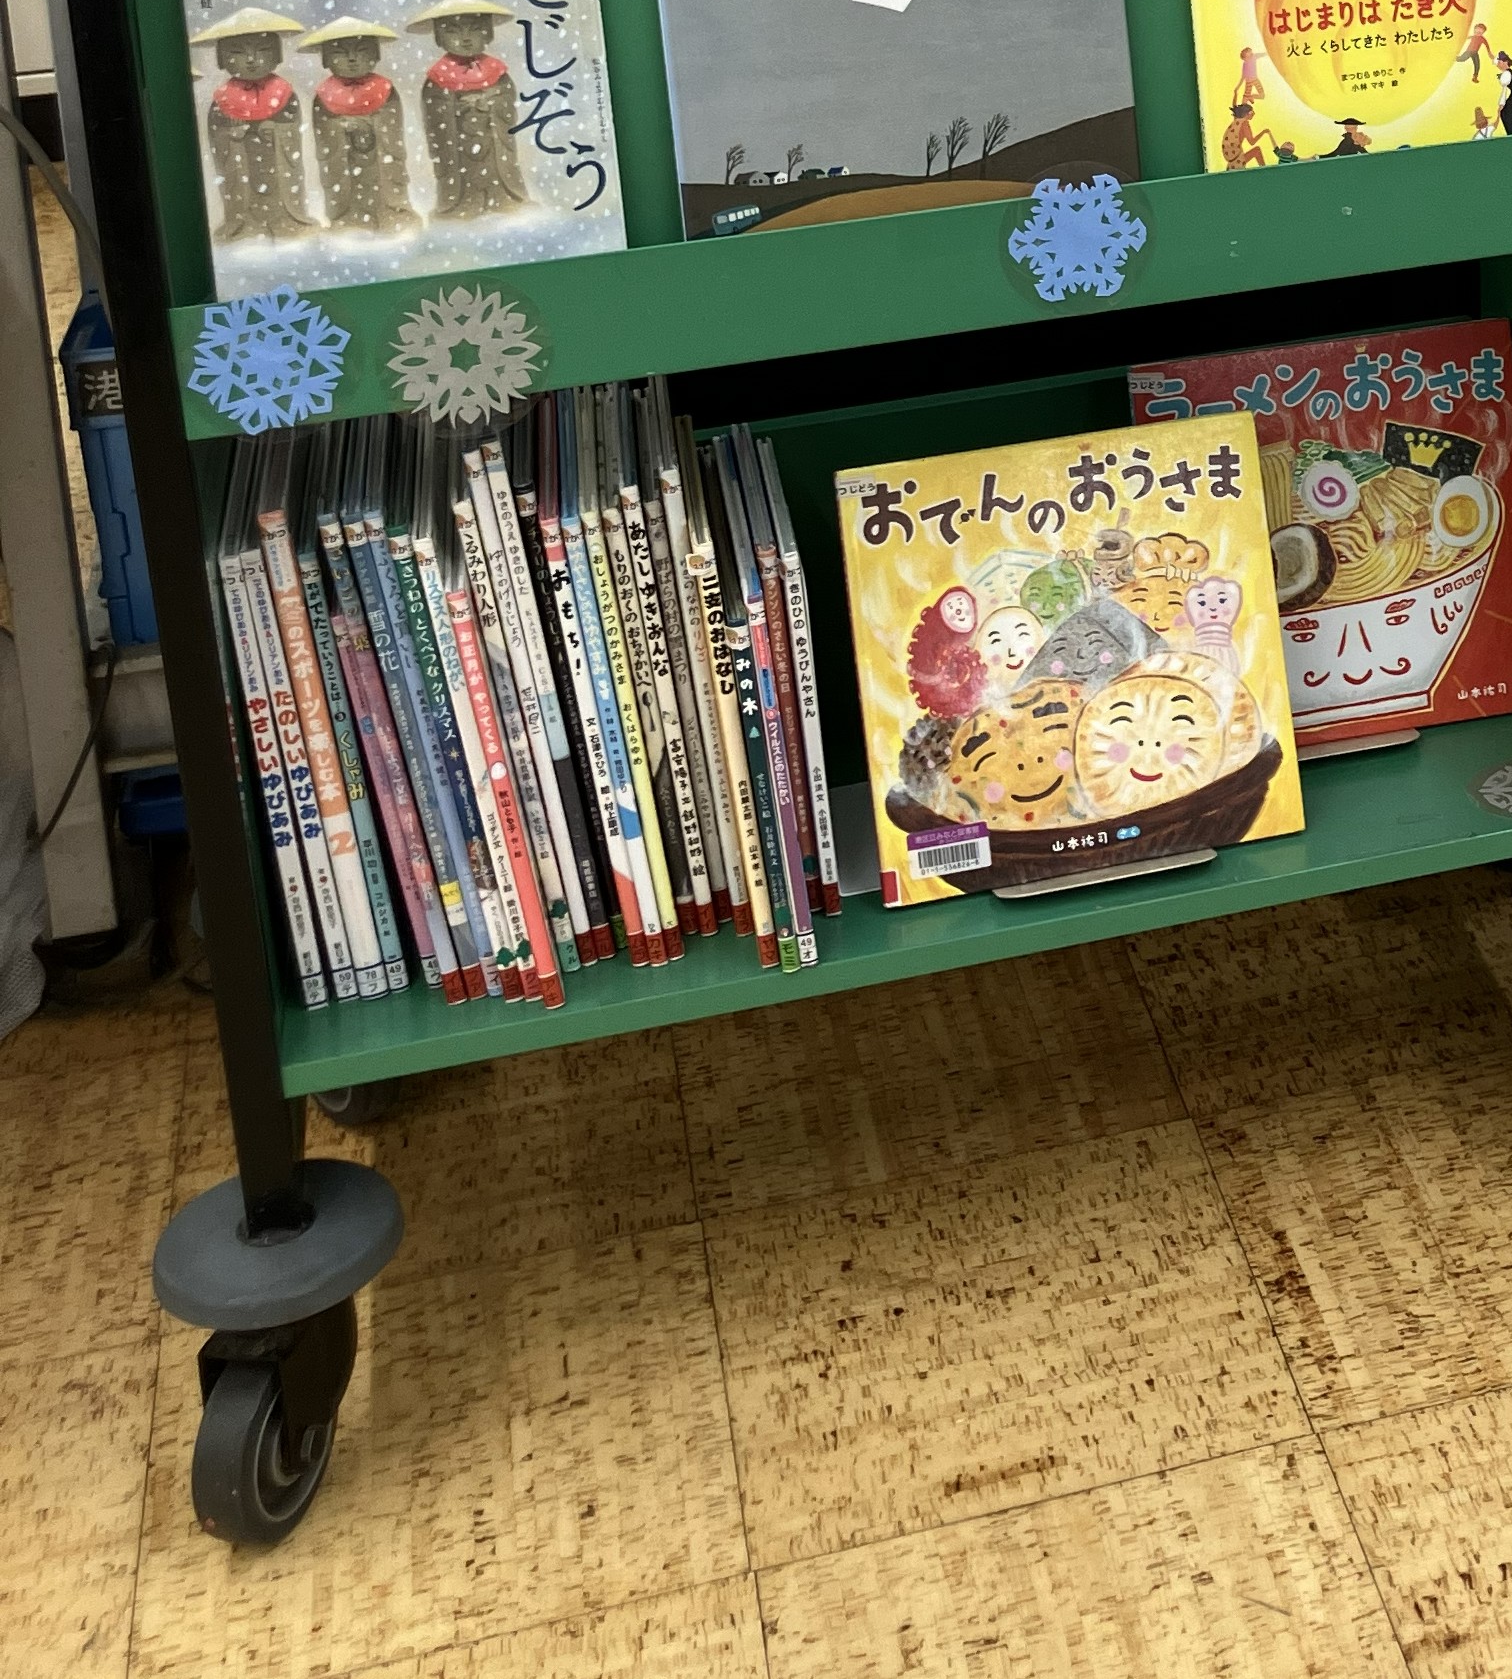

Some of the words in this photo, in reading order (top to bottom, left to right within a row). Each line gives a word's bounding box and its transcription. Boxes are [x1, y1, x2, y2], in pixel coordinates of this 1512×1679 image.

[1267, 0, 1381, 36] はじまりは
[1320, 33, 1388, 53] くらしてきた
[1393, 25, 1455, 46] わたしたち
[1144, 347, 1506, 421] ラーメンのおうさま
[860, 444, 1244, 547] おでんのおうさま
[496, 490, 516, 542] ゆきのうえ
[509, 544, 530, 596] ゆきのした
[628, 521, 651, 577] あたし
[367, 608, 400, 673] 雪の花
[592, 554, 627, 686] おしょうがつのかみさま
[613, 549, 638, 624] もりのおくの
[627, 625, 653, 688] おちゃかいへ
[639, 581, 670, 677] ゆきおんな
[416, 619, 440, 678] とくべつな
[431, 681, 457, 740] クリスマス
[1456, 682, 1507, 702] 山本祐司
[248, 696, 280, 773] やさしい
[273, 689, 307, 765] たのしい
[290, 765, 323, 840] ゆびあみ
[340, 730, 366, 801] くしゃみ
[262, 773, 294, 849] ゆびあみ
[327, 830, 356, 857] 2
[1051, 830, 1109, 853] 山本祐司
